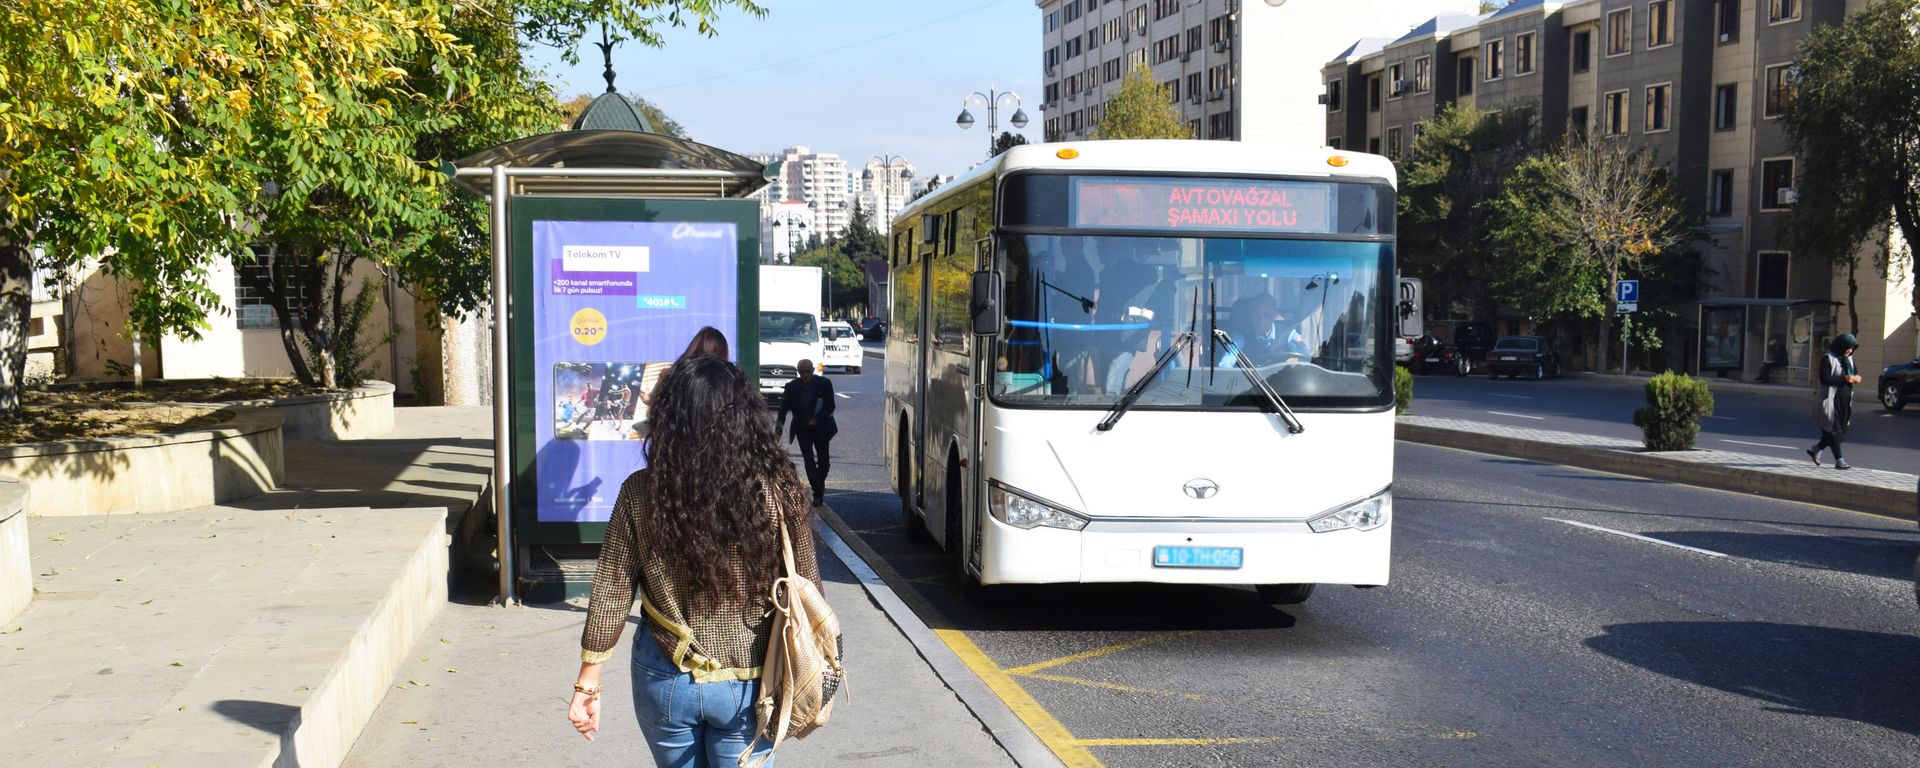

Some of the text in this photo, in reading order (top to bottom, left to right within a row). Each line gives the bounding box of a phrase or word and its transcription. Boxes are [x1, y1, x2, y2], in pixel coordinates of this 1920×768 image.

[1169, 186, 1293, 207] AVTOVAĞZAL
[1168, 208, 1297, 228] ŞAMAXI YOLU
[567, 250, 621, 259] Telekom TV
[570, 279, 587, 287] kanal
[588, 279, 633, 287] smartfonunda
[567, 287, 580, 295] gün
[580, 287, 603, 295] pulsuz!
[1621, 282, 1633, 300] P
